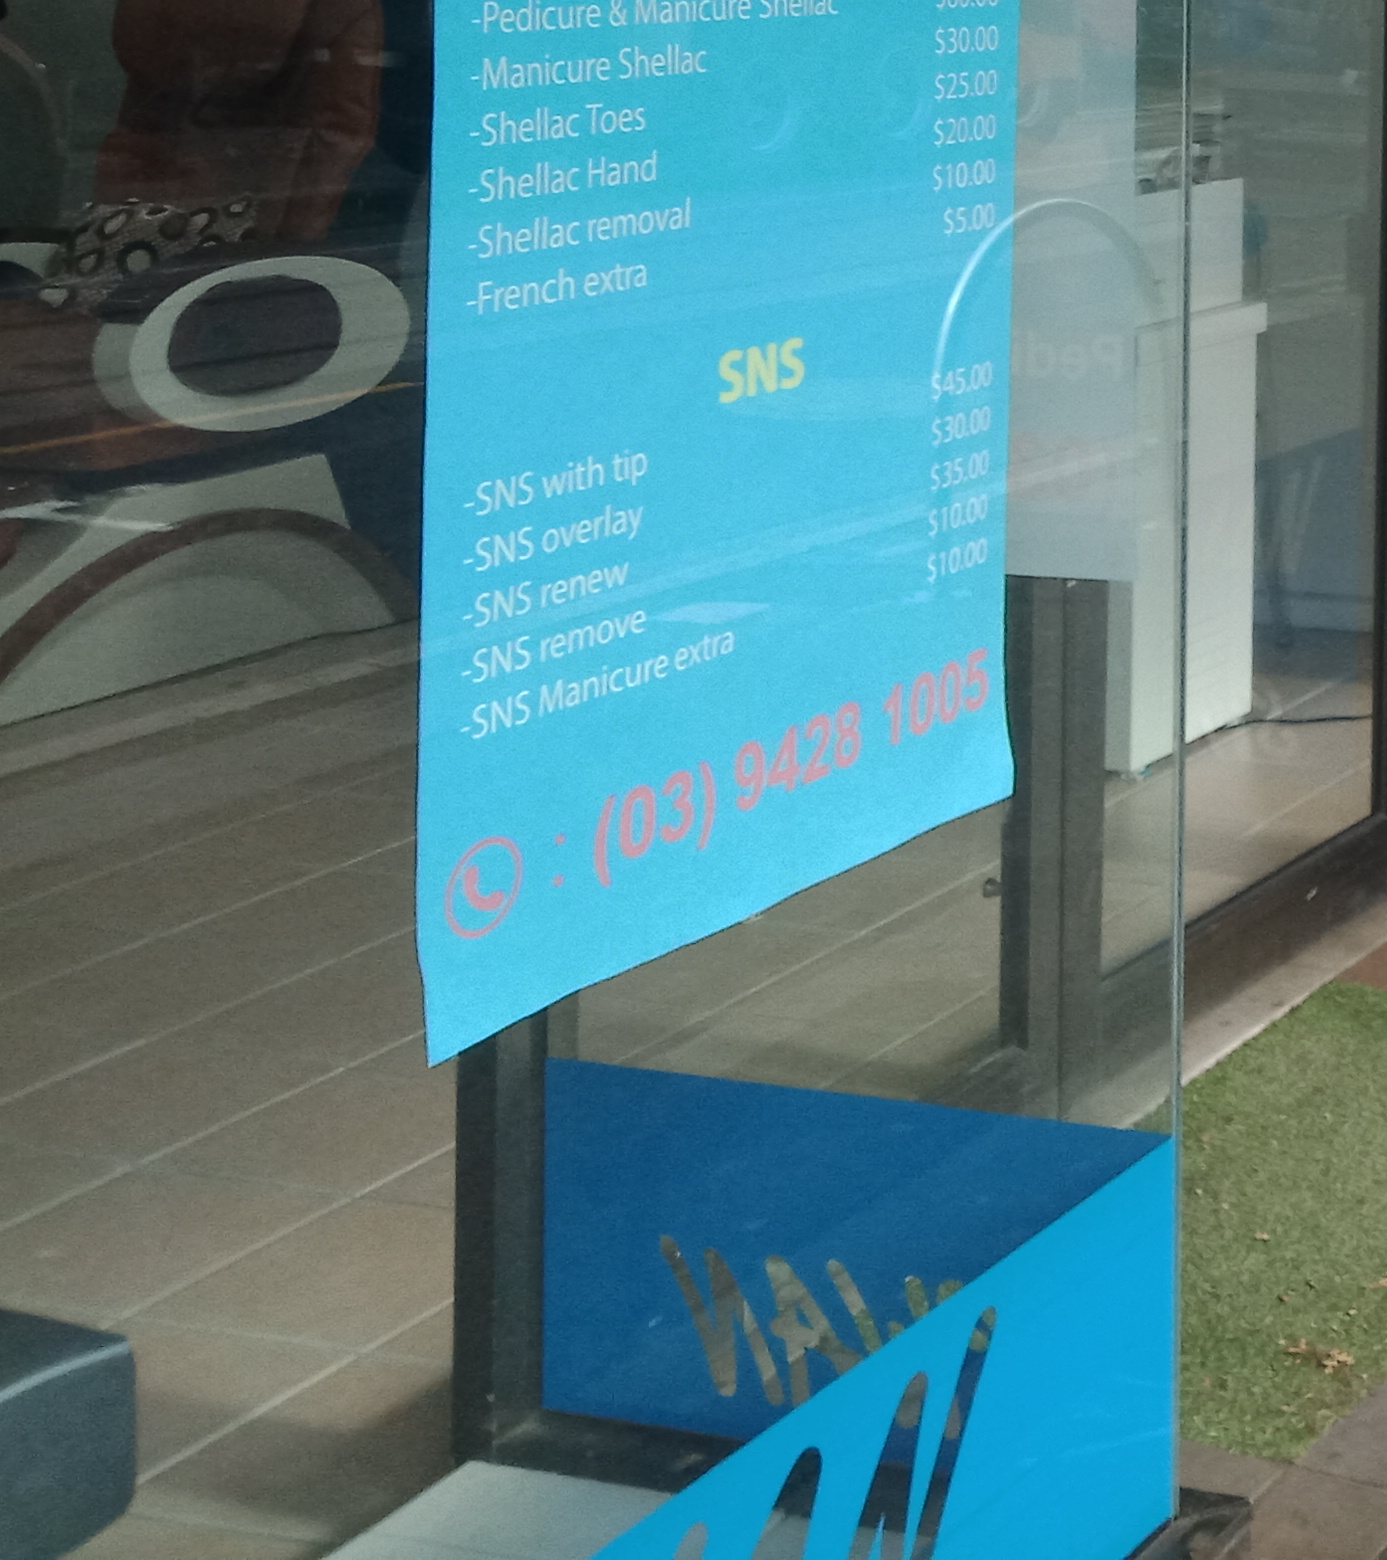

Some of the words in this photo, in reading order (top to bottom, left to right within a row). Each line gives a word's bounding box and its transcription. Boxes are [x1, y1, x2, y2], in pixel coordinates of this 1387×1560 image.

[586, 102, 646, 134] Toes
[934, 71, 997, 100] $25.00
[619, 44, 707, 80] Shellac
[935, 26, 998, 54] $30.00
[587, 151, 657, 189] Hand
[934, 115, 996, 147] $20.00
[587, 198, 691, 241] removal
[933, 160, 995, 191] $10.00
[584, 263, 647, 295] extra
[943, 204, 995, 234] $5.00
[719, 338, 805, 403] SNS
[542, 456, 604, 499] with
[612, 448, 648, 486] tip
[931, 362, 992, 400] $45.00
[542, 504, 644, 554] overlay
[931, 406, 991, 445] $30.00
[540, 608, 646, 661] remove
[928, 494, 988, 536] $10.00
[541, 562, 628, 608] renew
[930, 450, 990, 490] $35.00
[538, 654, 669, 716] Manicure
[674, 631, 734, 671] extra
[926, 539, 988, 584] $10.00
[593, 762, 717, 887] (03)
[734, 701, 861, 811] 9428
[884, 648, 988, 746] 1005
